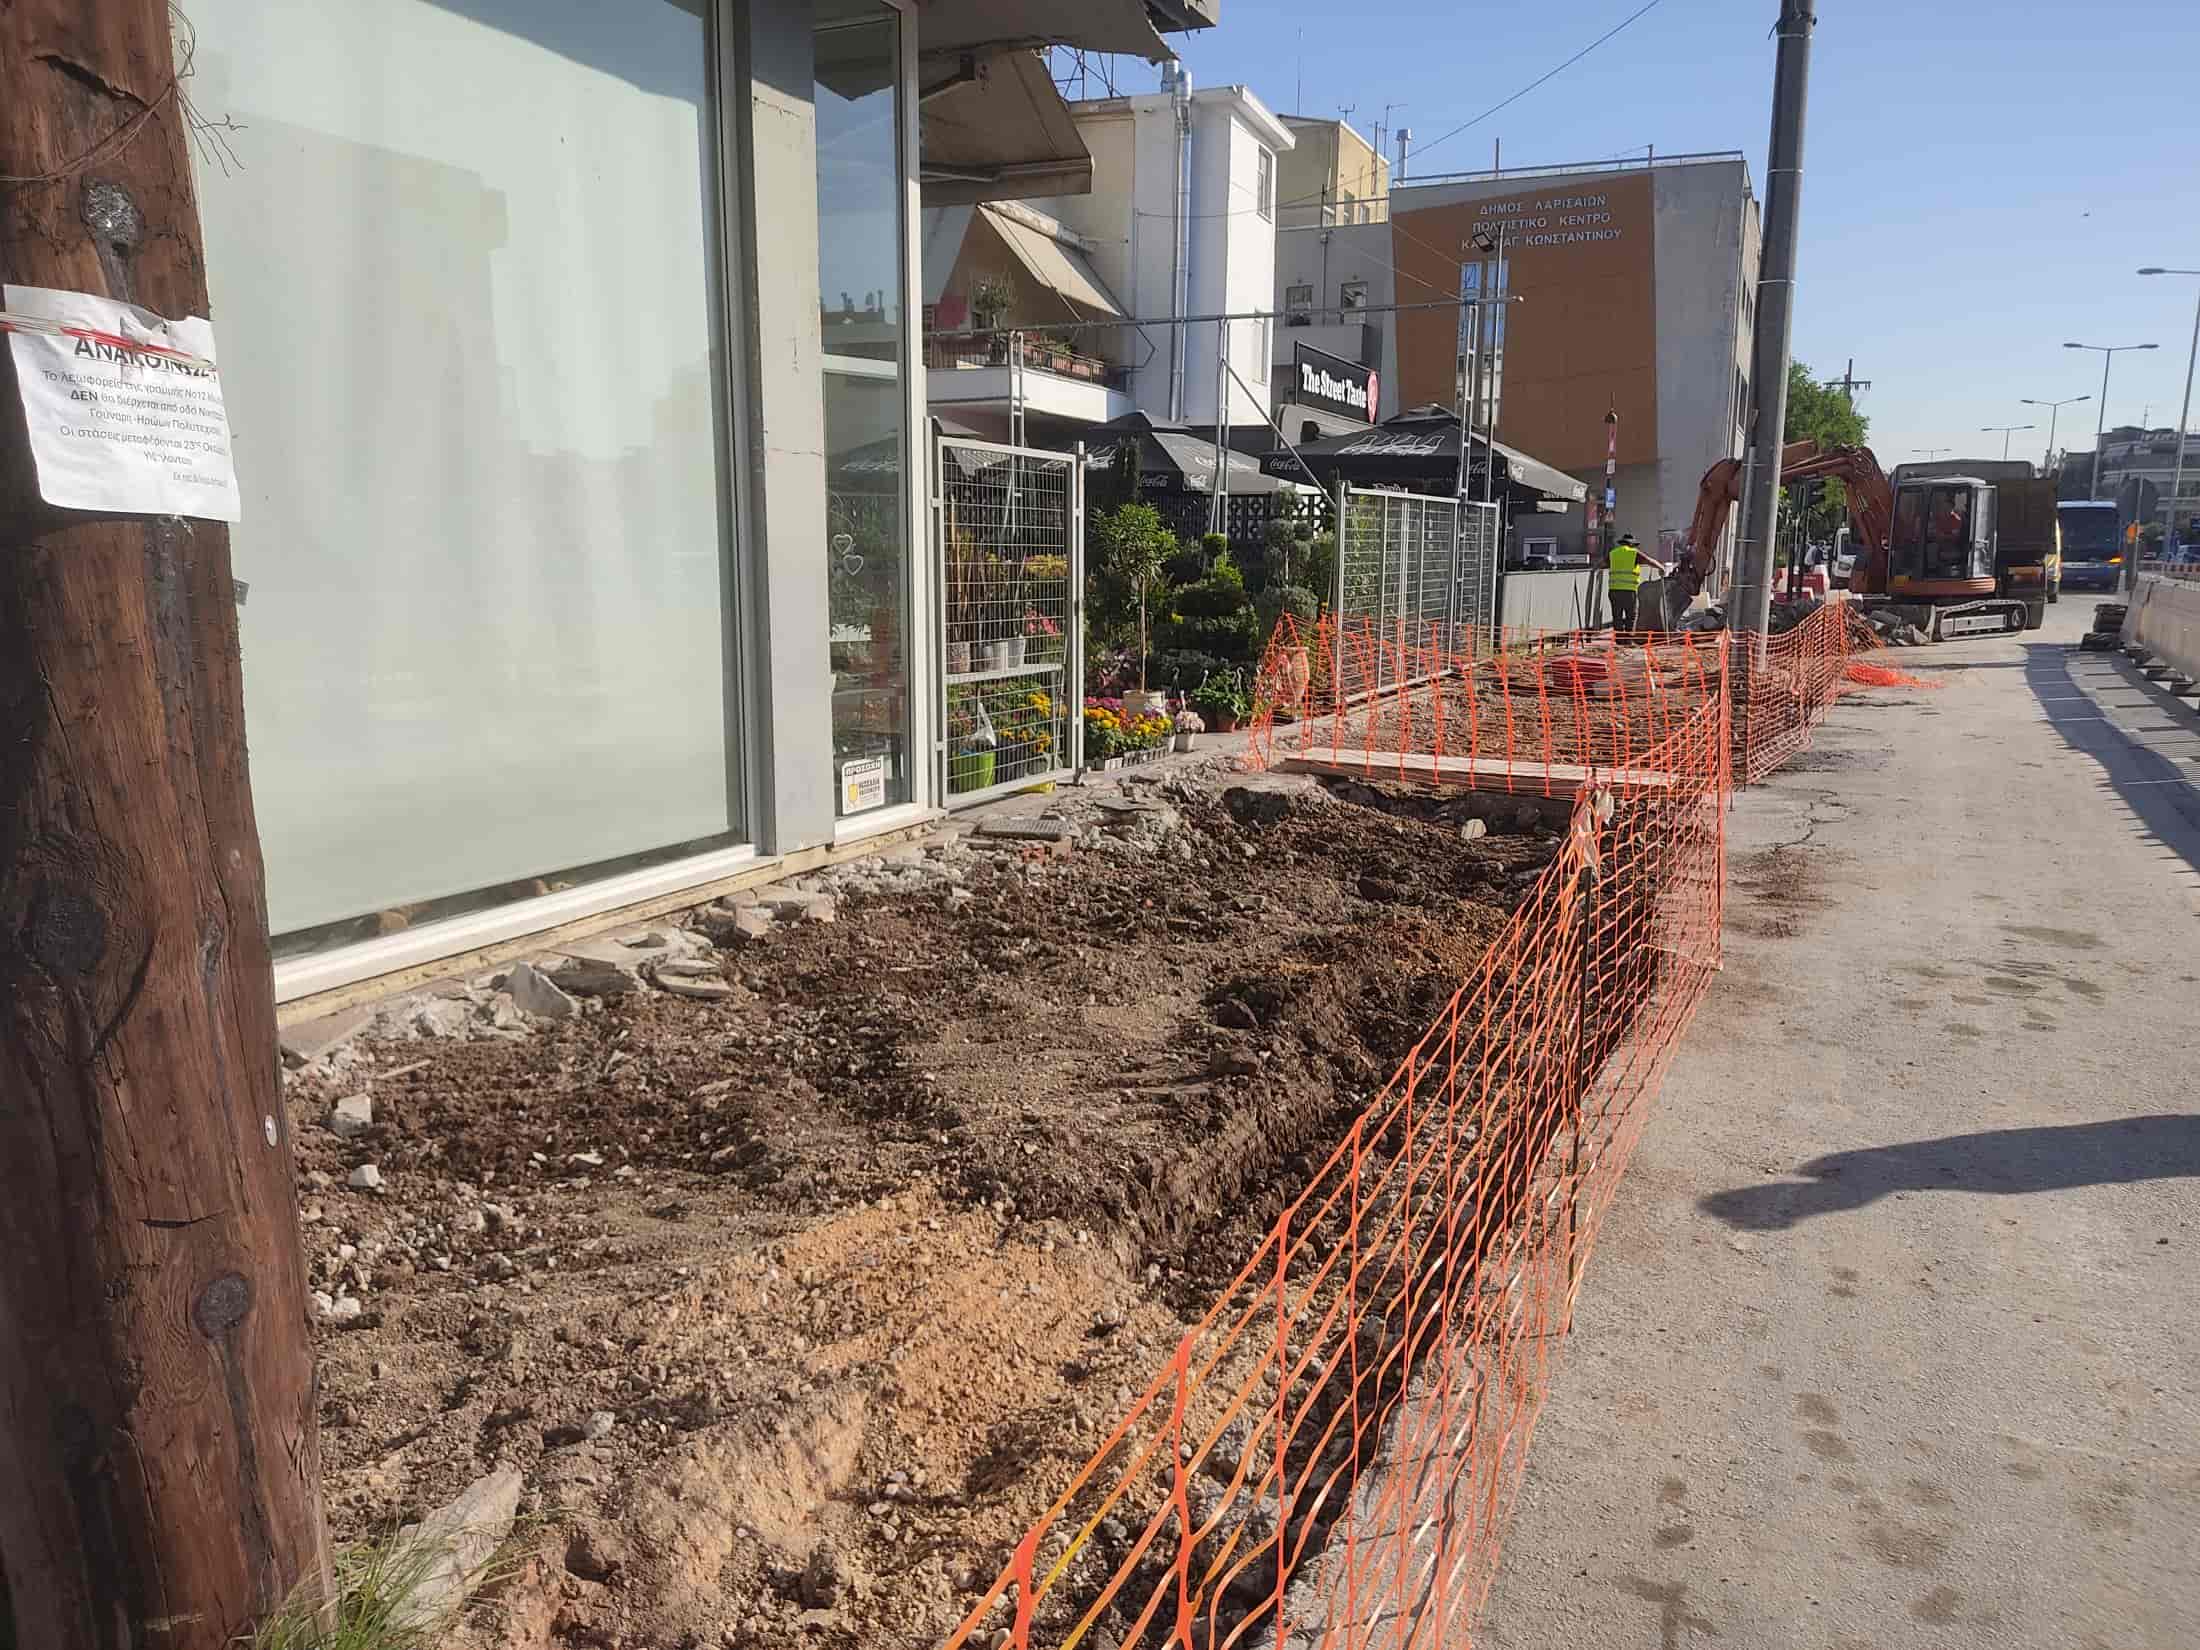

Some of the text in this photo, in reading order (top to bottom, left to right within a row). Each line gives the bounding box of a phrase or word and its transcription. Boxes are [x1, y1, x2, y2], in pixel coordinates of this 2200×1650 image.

[1480, 195, 1607, 215] ΔΗΜΟΣ ΛΑΡΙΣΑΙΩΝ
[1560, 212, 1610, 227] ΚΕΝΤΡΟ
[1526, 229, 1622, 247] ΚΩΝΣΤΑΝΤΙΝΟΥ
[1302, 363, 1320, 394] The
[1320, 370, 1346, 402] Street
[71, 390, 98, 401] ΔΕΝ
